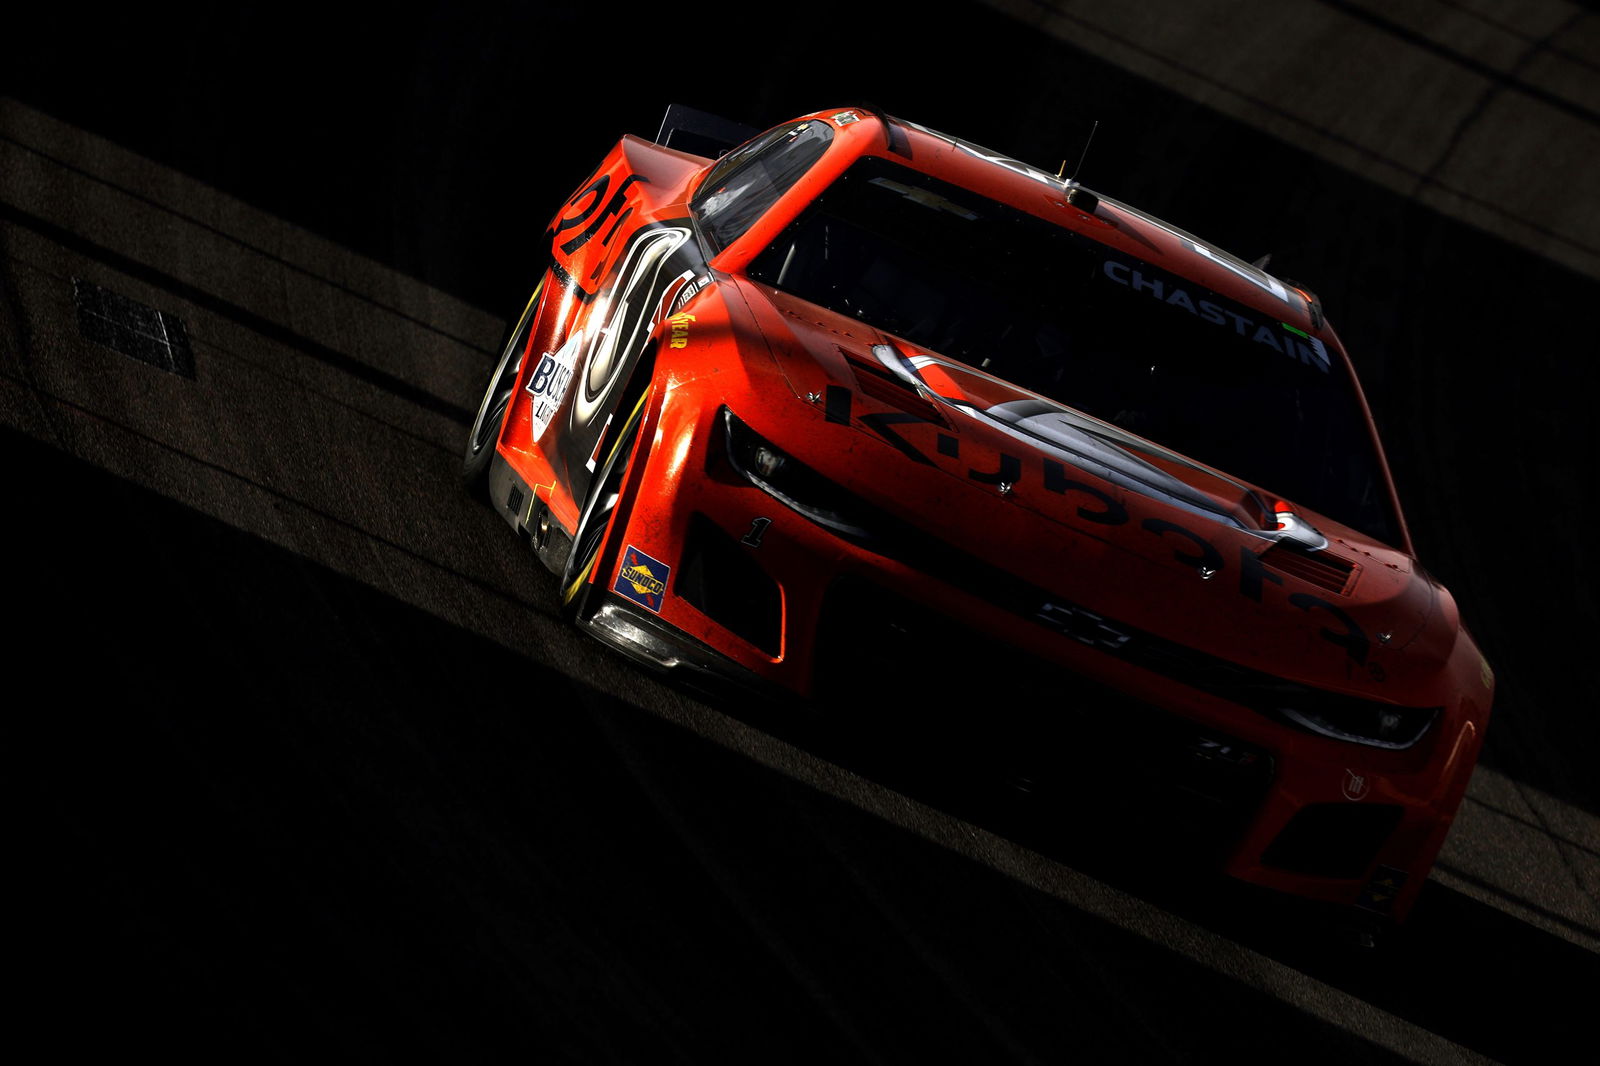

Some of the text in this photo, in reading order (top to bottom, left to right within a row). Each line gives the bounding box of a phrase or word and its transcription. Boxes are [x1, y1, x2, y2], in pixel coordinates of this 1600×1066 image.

[1103, 259, 1331, 375] CHASTAIN
[741, 516, 774, 548] 1
[622, 566, 664, 595] SUNOCO
